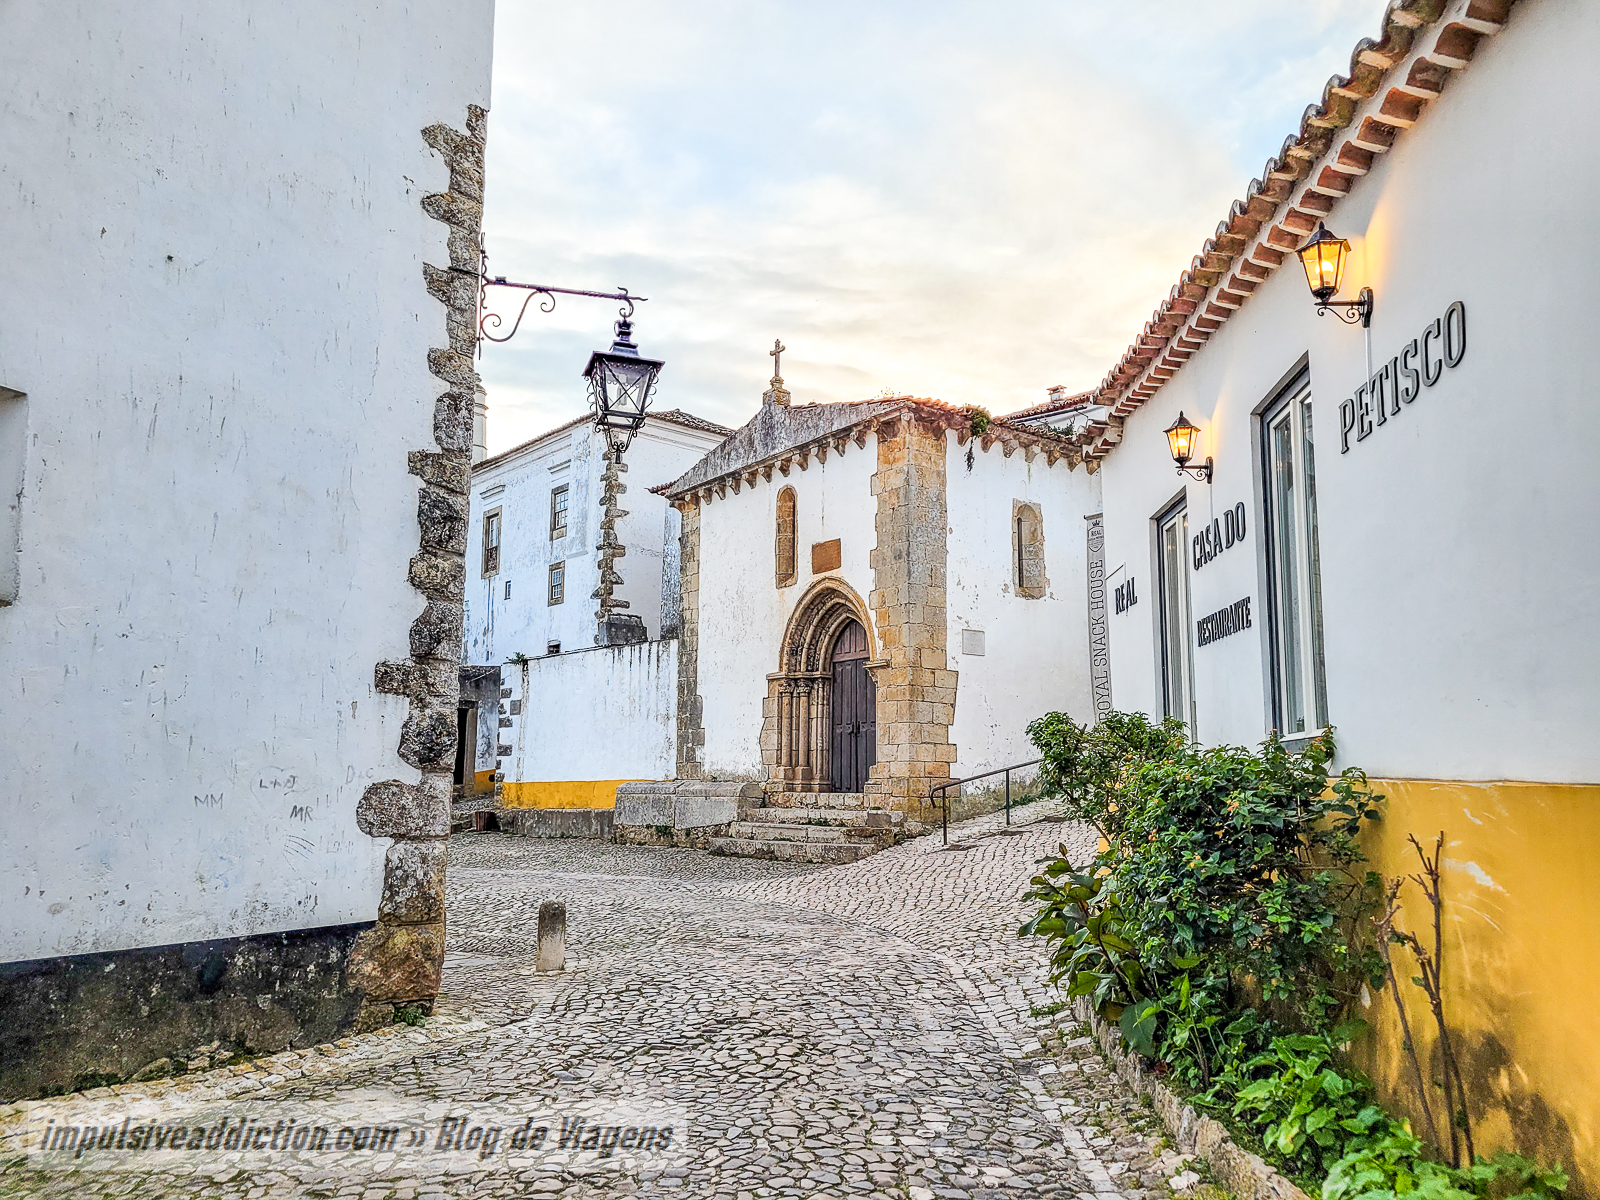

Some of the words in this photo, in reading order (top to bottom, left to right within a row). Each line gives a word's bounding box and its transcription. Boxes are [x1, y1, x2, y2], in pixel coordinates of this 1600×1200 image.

[1114, 578, 1138, 615] REAL
[1192, 518, 1223, 571] CASA
[1224, 501, 1247, 550] DO
[1338, 301, 1467, 454] PETISCO
[1090, 559, 1105, 610] HOUSE
[1092, 614, 1107, 667] SNACK
[1197, 596, 1252, 647] RESTAURANTE
[1094, 670, 1111, 722] ROYAL
